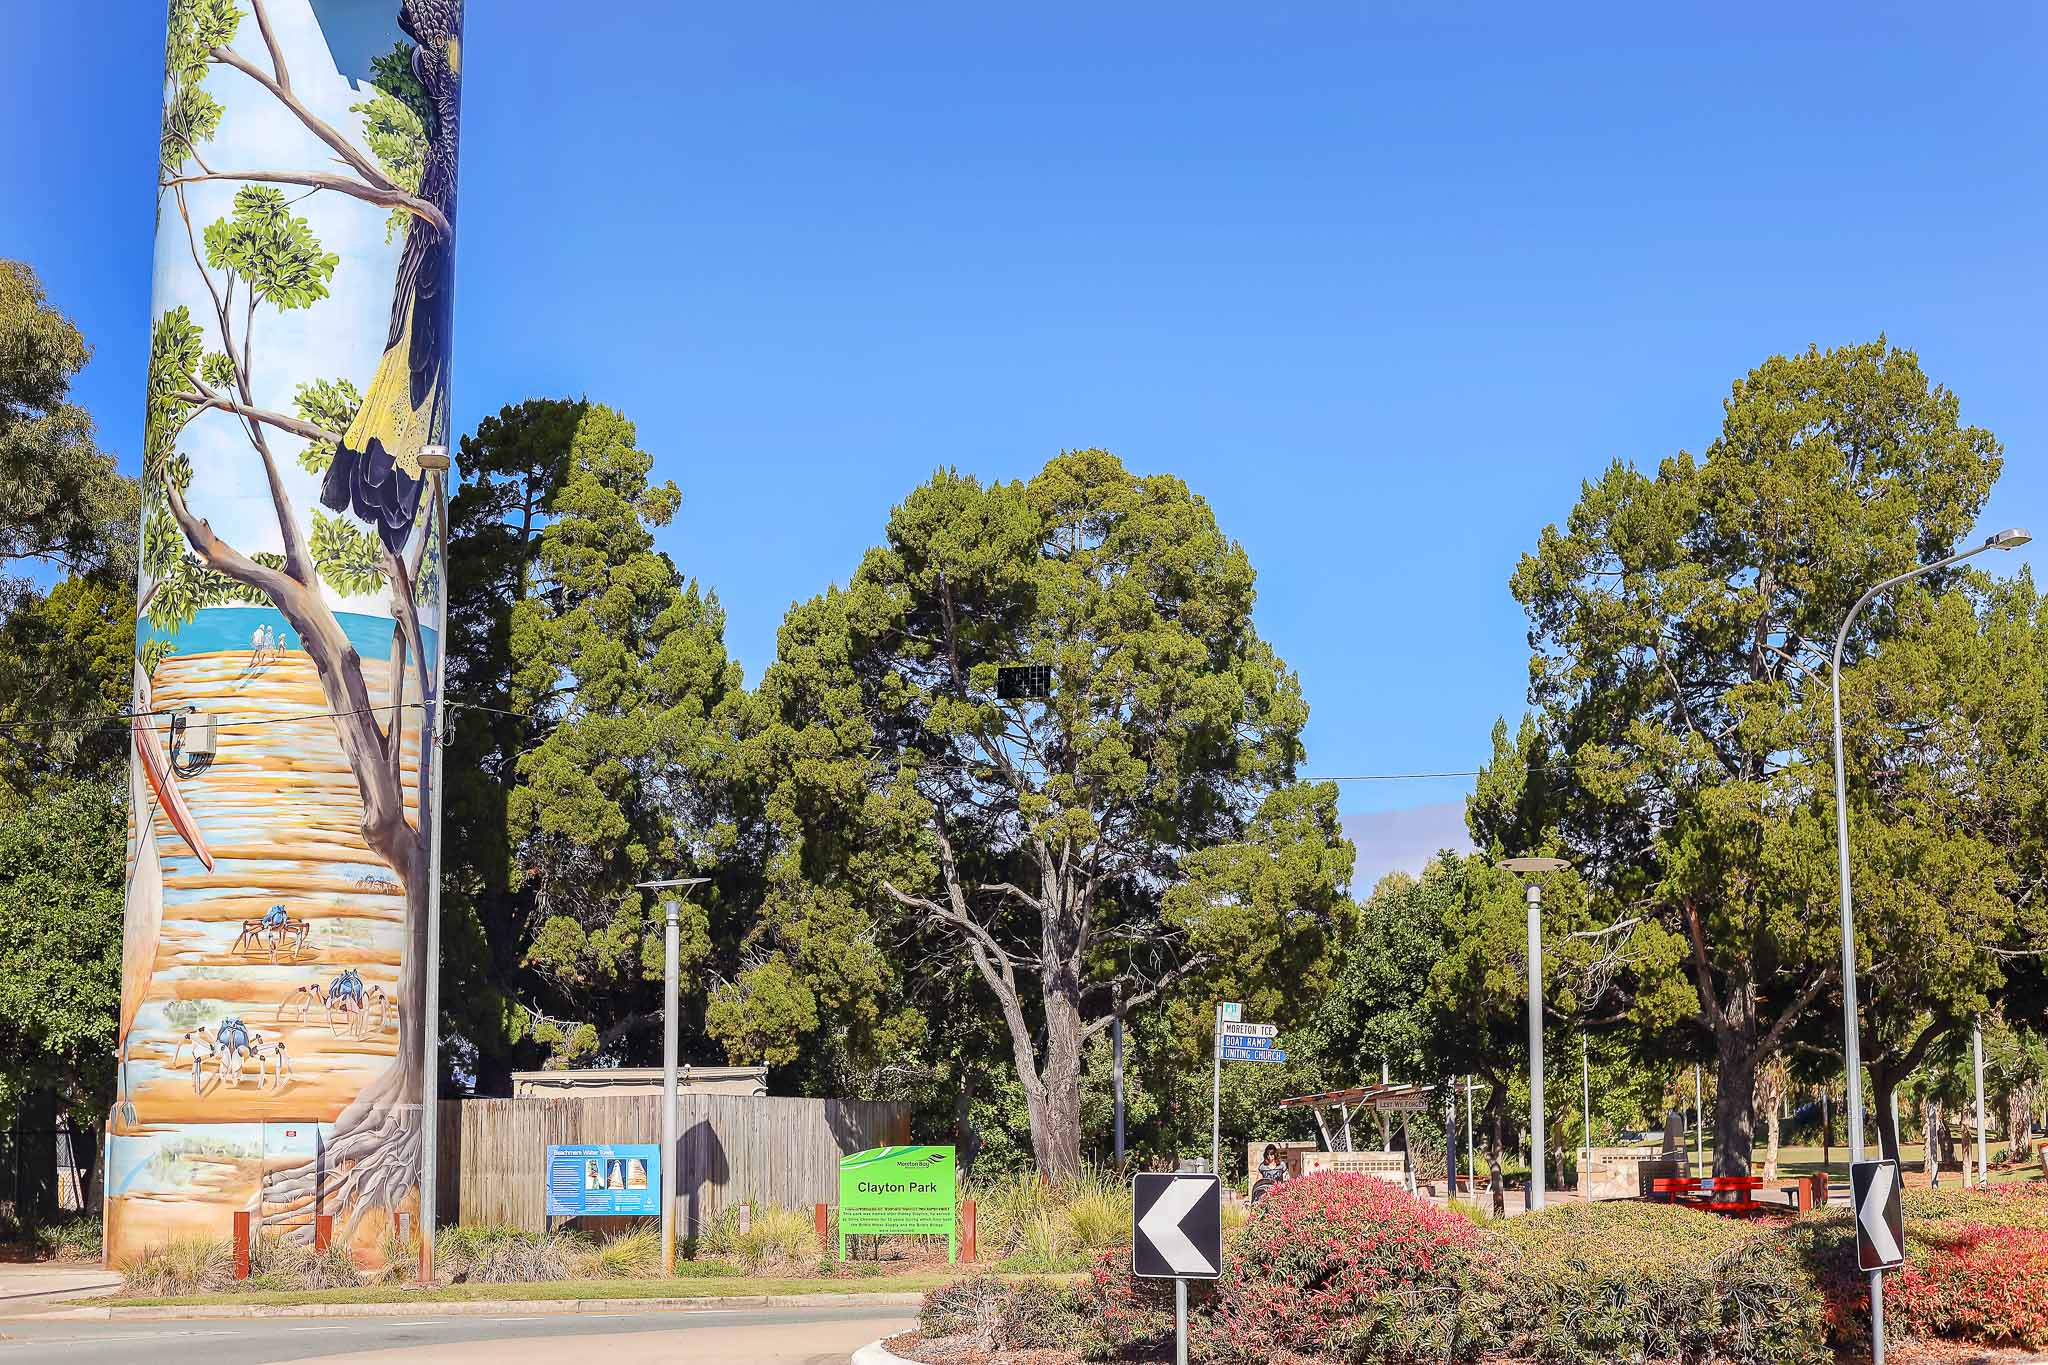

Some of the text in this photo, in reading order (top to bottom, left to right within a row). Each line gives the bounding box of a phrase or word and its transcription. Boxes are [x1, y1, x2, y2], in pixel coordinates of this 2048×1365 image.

[1226, 1024, 1273, 1036] MORETON TCE
[1226, 1036, 1266, 1048] BOAT RAMP
[1225, 1048, 1281, 1061] UNITING CHURCH
[858, 1182, 937, 1195] Clayton Park
